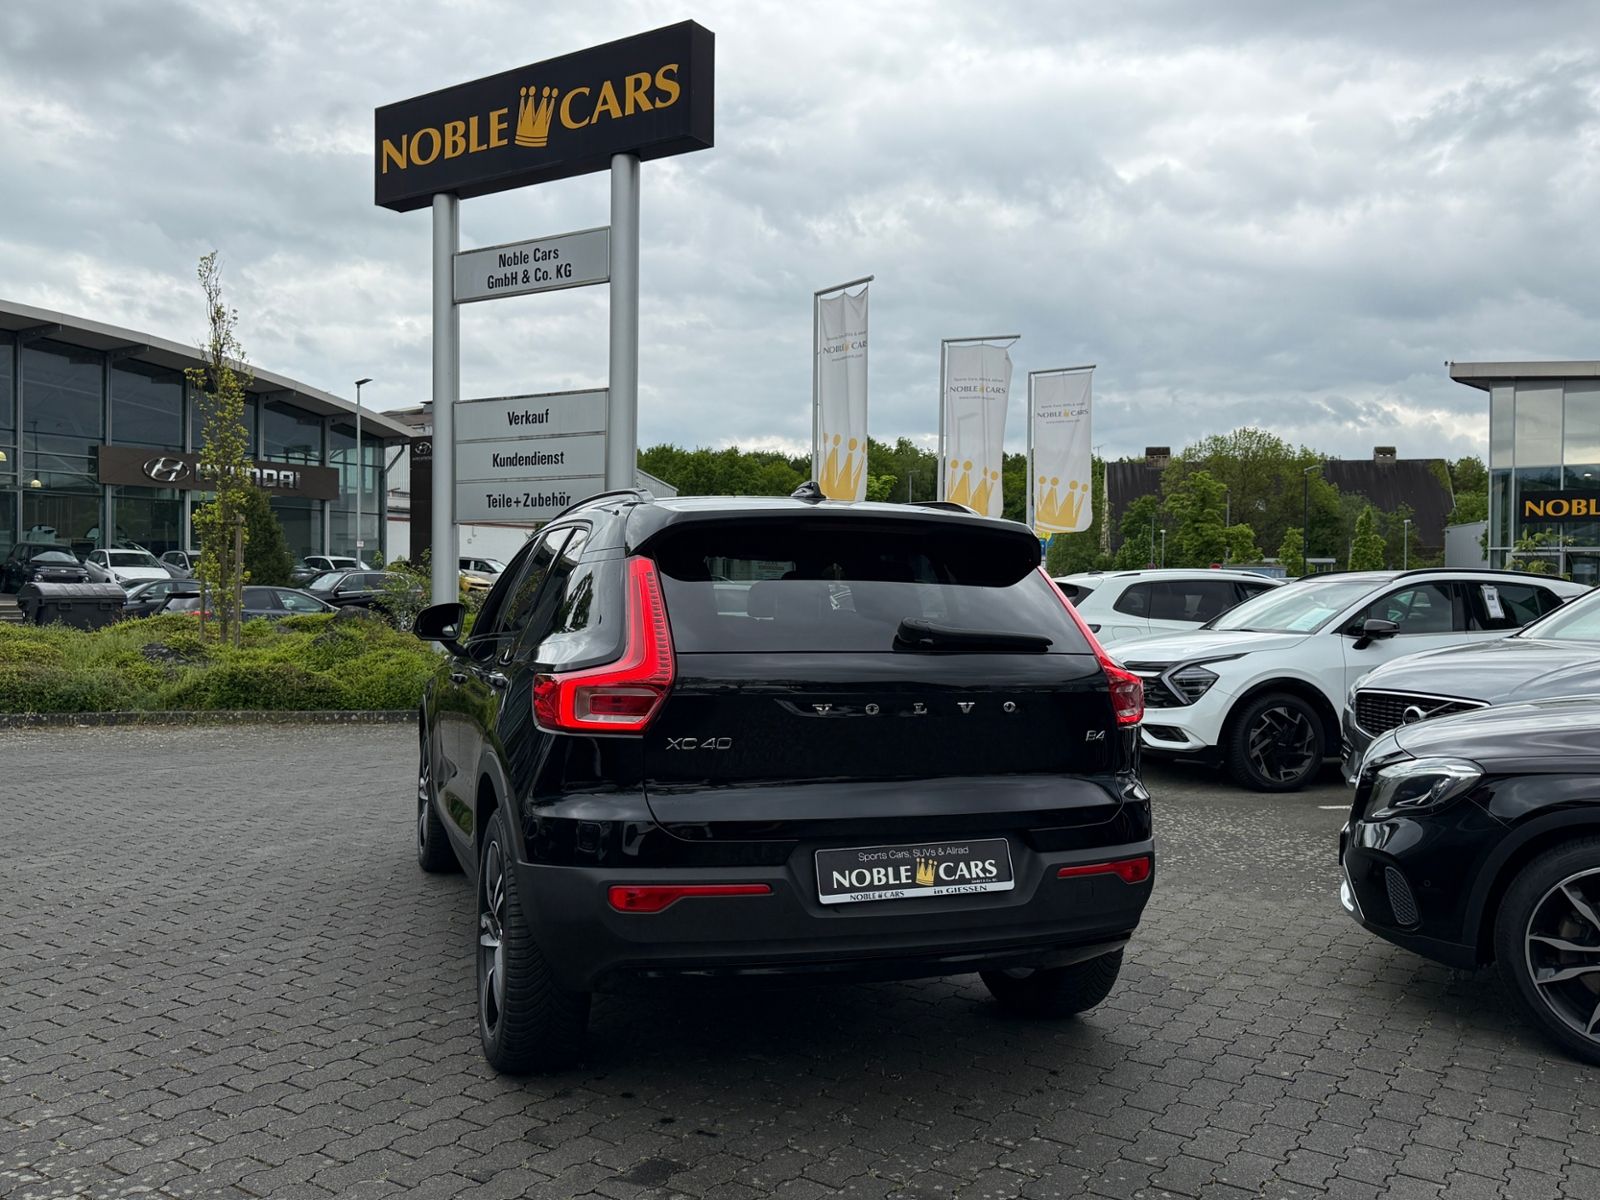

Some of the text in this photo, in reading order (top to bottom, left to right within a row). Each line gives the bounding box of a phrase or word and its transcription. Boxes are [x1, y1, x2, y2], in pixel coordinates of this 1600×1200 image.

[382, 63, 681, 174] NOBLE CARS
[498, 247, 559, 268] Noble Cars
[487, 263, 572, 289] GmbH & Co. KG
[950, 385, 1006, 394] NOBLE CARS
[507, 408, 550, 426] Verkauf
[492, 451, 565, 468] Kundendienst
[486, 491, 571, 509] Teile+Zubehör
[812, 701, 1016, 716] VOLVO
[1085, 730, 1105, 742] B4
[858, 852, 888, 862] Sports
[913, 848, 937, 858] SUVs
[937, 847, 945, 856] &
[945, 846, 970, 855] Allrad
[832, 859, 998, 889] NOBLE CARS
[849, 891, 905, 901] NOBLE CARS
